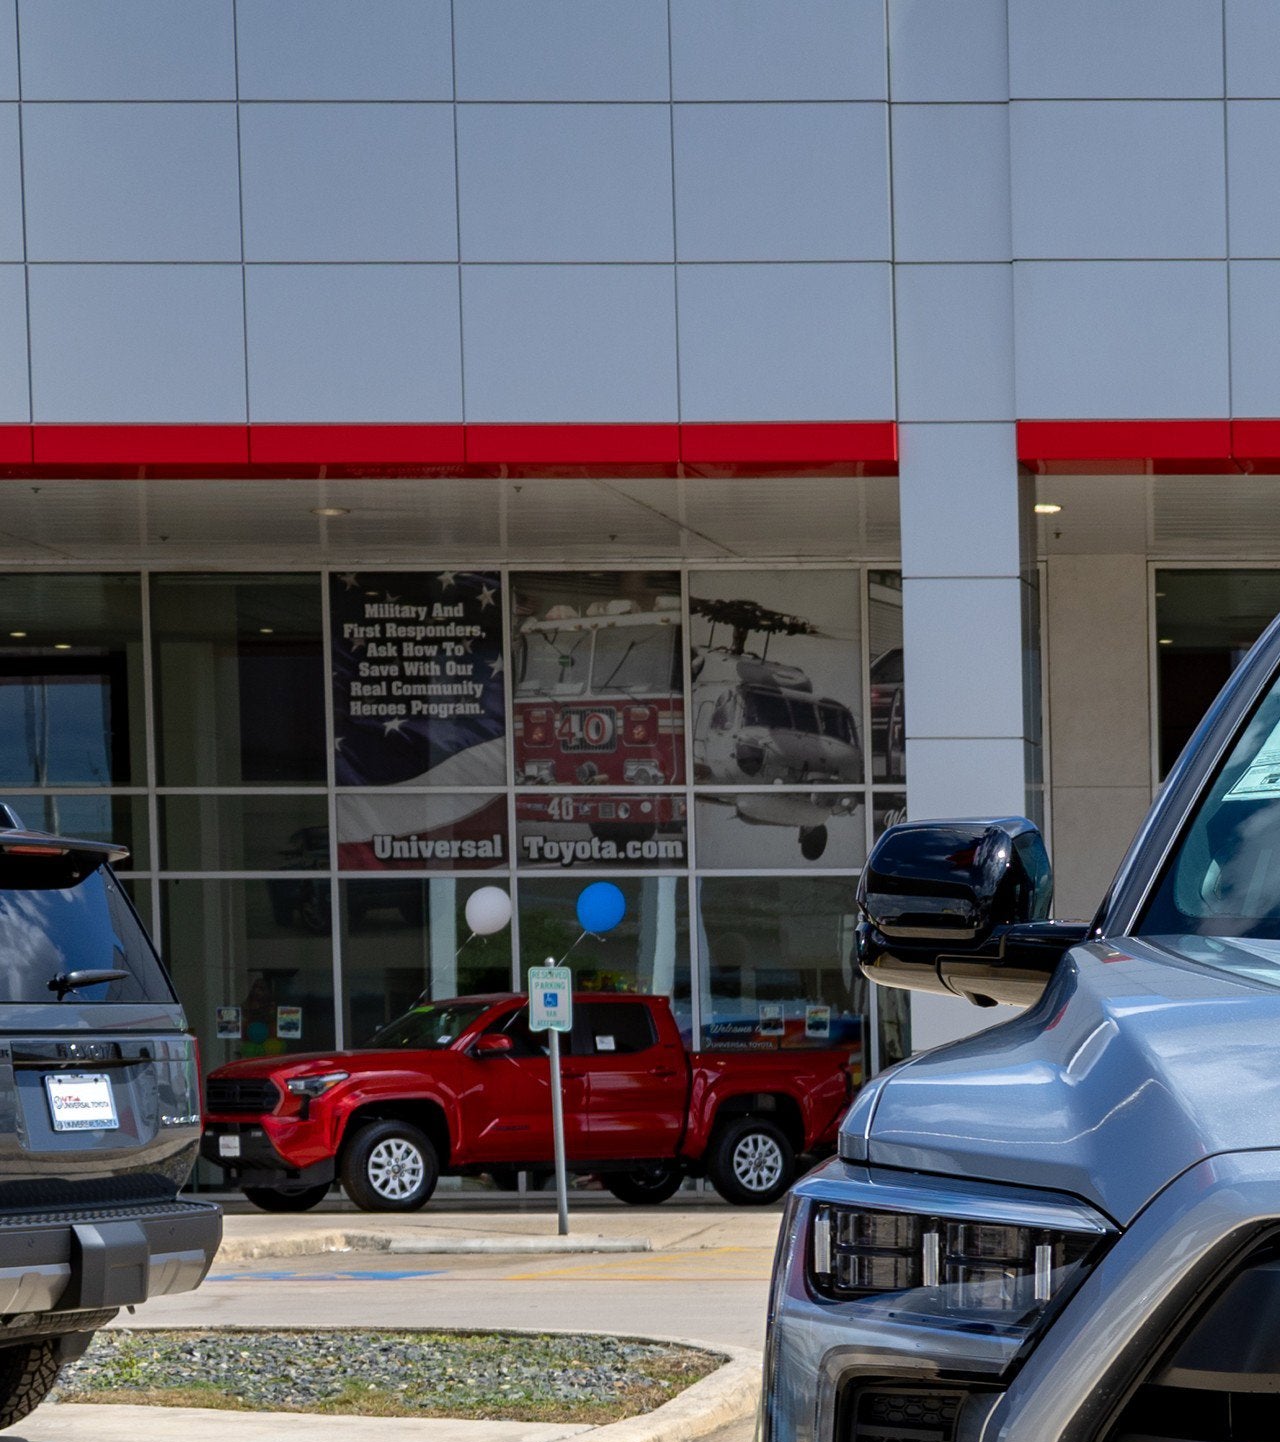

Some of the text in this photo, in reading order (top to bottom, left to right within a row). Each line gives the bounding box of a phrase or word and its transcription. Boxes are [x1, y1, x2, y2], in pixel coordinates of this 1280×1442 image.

[364, 602, 463, 620] Military And
[343, 622, 486, 640] First Responders,
[366, 641, 464, 657] Ask How To
[358, 661, 473, 676] Save With Our
[350, 681, 484, 698] Real Community
[350, 700, 485, 718] Heroes Program.
[556, 711, 613, 746] 40
[547, 797, 574, 820] 40
[373, 834, 683, 864] Universal Toyota.com
